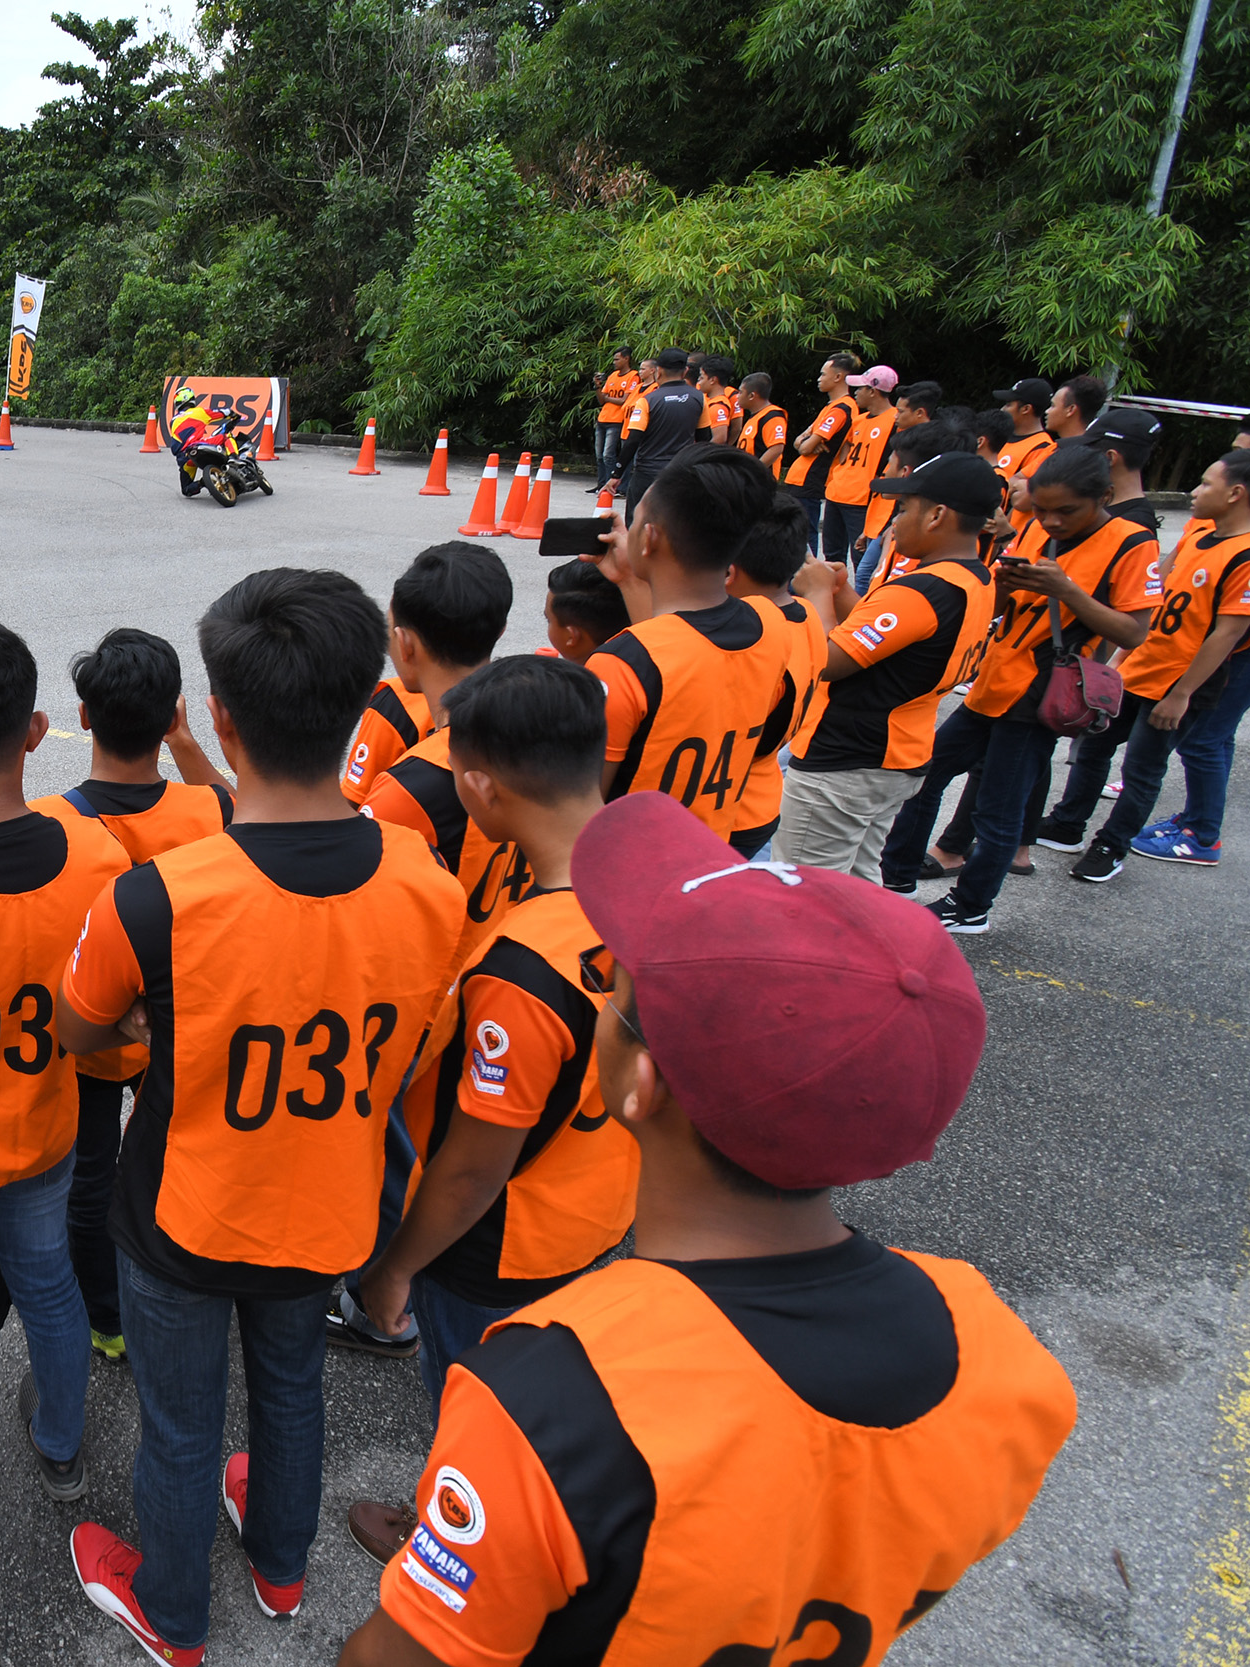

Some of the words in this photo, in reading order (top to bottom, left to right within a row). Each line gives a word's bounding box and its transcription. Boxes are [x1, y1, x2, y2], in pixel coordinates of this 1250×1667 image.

[841, 442, 871, 468] 41
[1150, 589, 1192, 636] 18
[658, 722, 765, 811] 047
[467, 841, 532, 922] 04
[446, 1496, 468, 1523] KBS
[412, 1526, 468, 1583] YAMAHA
